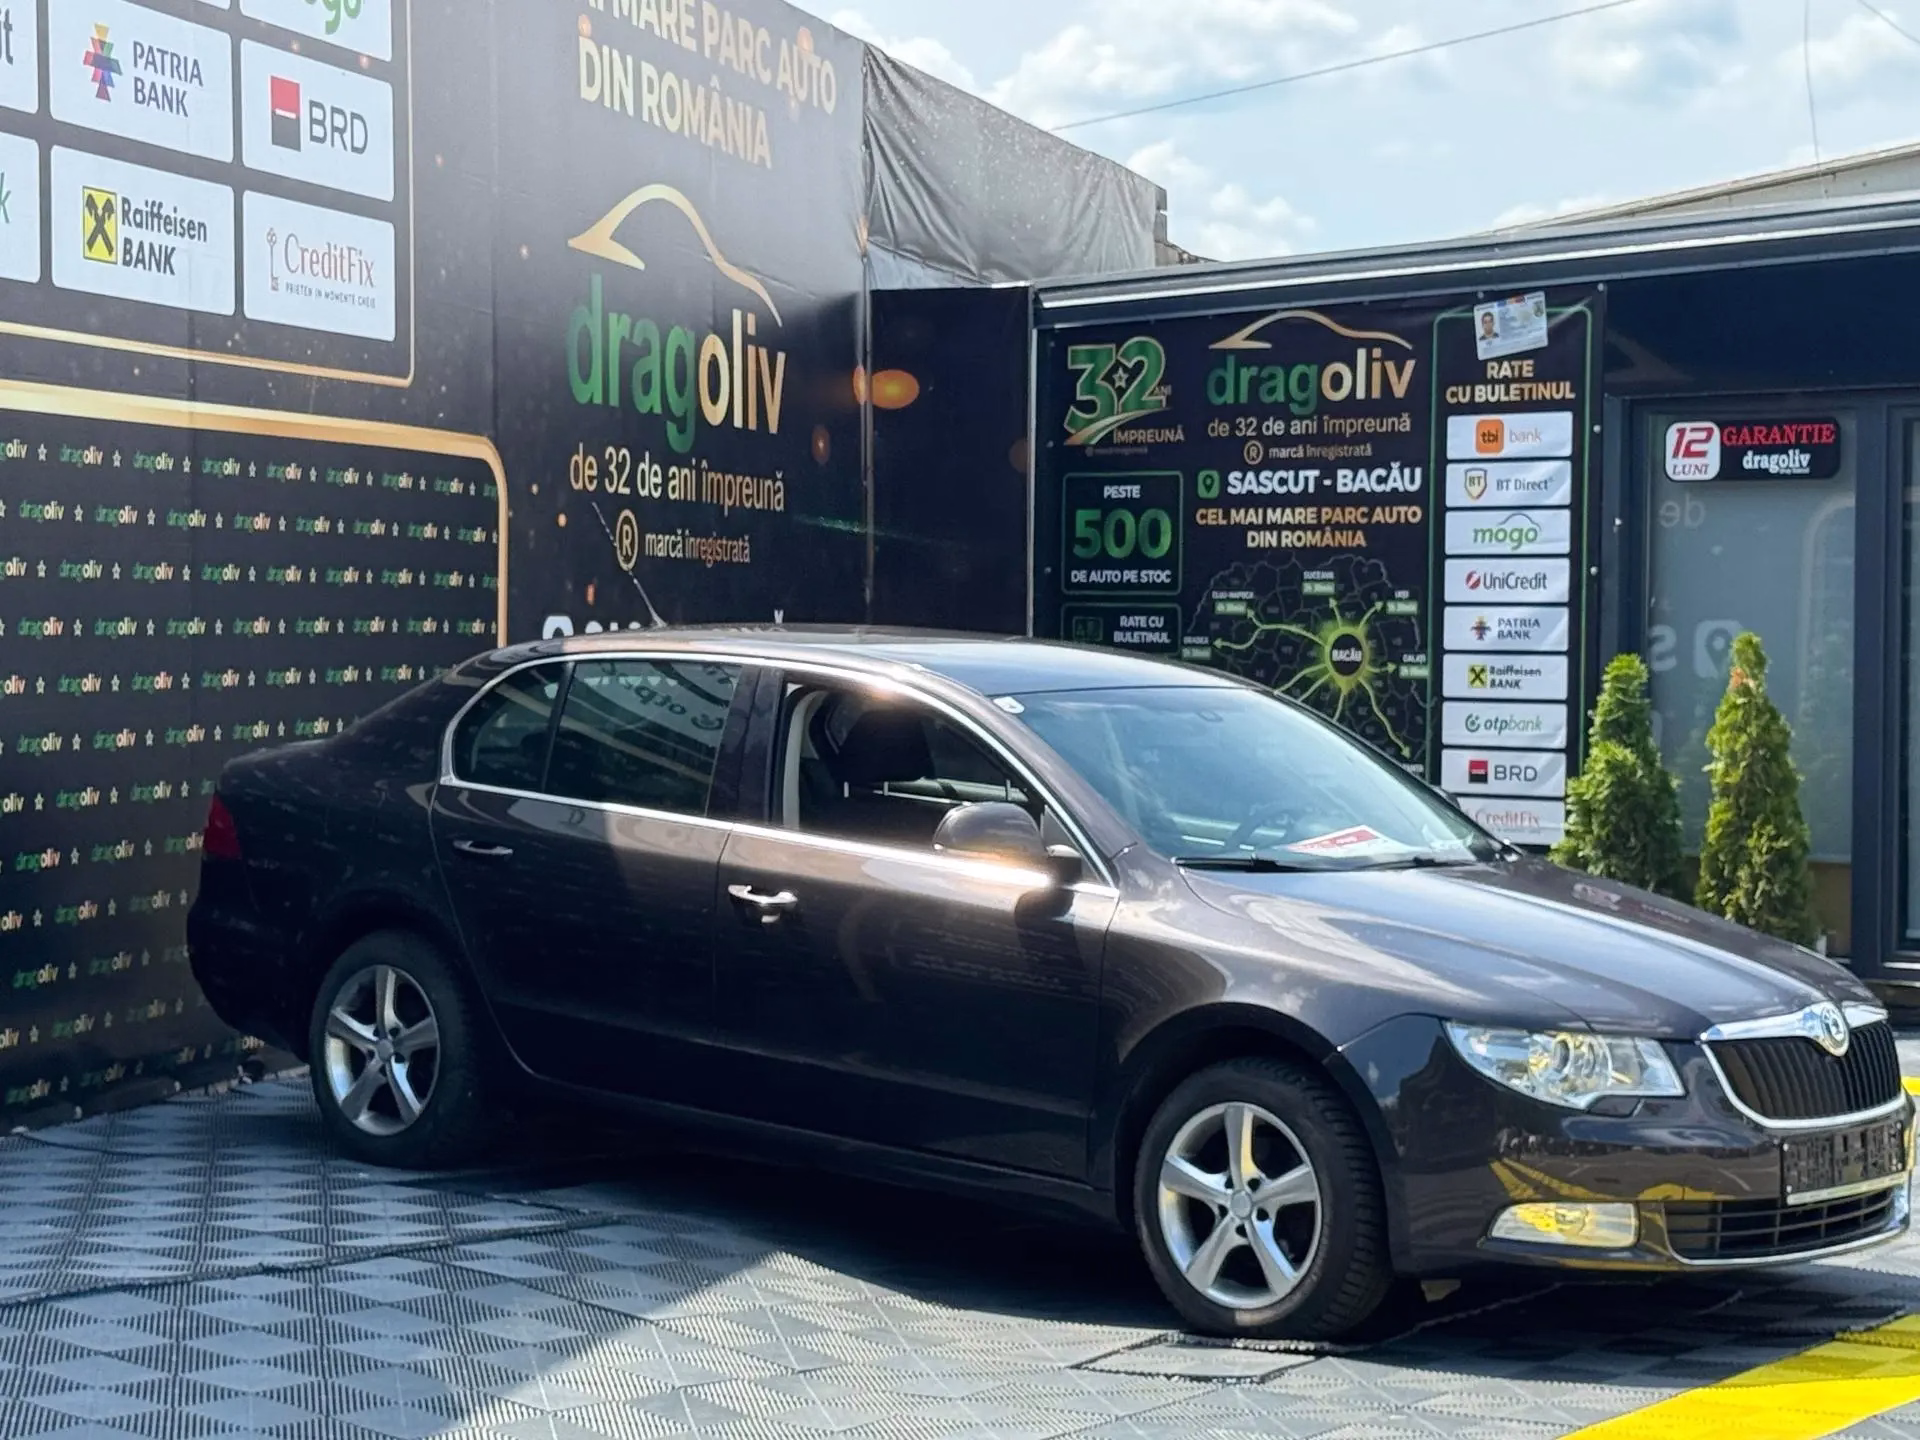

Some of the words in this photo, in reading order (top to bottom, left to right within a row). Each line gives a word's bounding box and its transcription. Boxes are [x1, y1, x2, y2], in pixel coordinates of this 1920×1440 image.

[132, 40, 204, 87] PATRIA
[702, 3, 772, 85] PARC
[776, 38, 837, 115] AUTO
[133, 76, 189, 118] BANK
[579, 35, 634, 117] DIN
[641, 60, 772, 170] ROMÂNIA
[309, 100, 368, 155] BRD
[121, 196, 208, 244] Raiffeisen
[122, 237, 176, 276] BANK
[284, 233, 375, 288] CreditFix
[566, 272, 787, 453] dragoliv
[1486, 360, 1535, 379] RATE
[1063, 336, 1166, 433] 32
[1206, 347, 1416, 416] dragoliv
[1445, 385, 1471, 404] CU
[1474, 381, 1576, 403] BULETINUL
[1208, 419, 1230, 437] de
[1235, 418, 1257, 436] 32
[1262, 416, 1285, 435] de
[1290, 416, 1317, 434] ani
[1323, 412, 1411, 438] împreună
[1481, 430, 1499, 444] tbi
[1509, 428, 1542, 444] bank
[1722, 423, 1836, 446] GARANTIE
[1269, 444, 1304, 459] marcă
[1672, 426, 1714, 459] 12
[59, 444, 103, 468] dragoliv
[132, 451, 174, 474] dragoliv
[201, 457, 241, 479] dragoliv
[1672, 463, 1710, 476] LUNI
[1742, 449, 1811, 474] dragoliv
[570, 442, 598, 492] de
[605, 446, 631, 494] 32
[637, 451, 662, 499] de
[668, 458, 696, 502] ani
[701, 462, 785, 517] împreună
[1227, 469, 1320, 495] SASCUT
[1336, 461, 1423, 493] BACĂU
[1468, 475, 1483, 488] BT
[1496, 478, 1512, 492] BT
[1514, 477, 1548, 493] Direct
[1103, 484, 1141, 499] PESTE
[19, 500, 65, 523] dragoliv
[94, 504, 138, 528] dragoliv
[166, 509, 207, 530] dragoliv
[234, 512, 271, 533] dragoliv
[1196, 508, 1229, 525] CEL
[1230, 507, 1263, 524] MAI
[1267, 507, 1317, 524] MARE
[1321, 507, 1369, 523] PARC
[1371, 506, 1422, 523] AUTO
[1072, 508, 1172, 560] 500
[1247, 532, 1279, 547] DIN
[1280, 527, 1366, 547] ROMÂNIA
[1473, 527, 1538, 551] mogo
[645, 529, 683, 558] marcă
[685, 530, 750, 568] înregistrată
[58, 559, 103, 582] dragoliv
[131, 561, 174, 584] dragoliv
[201, 563, 241, 585] dragoliv
[1071, 570, 1088, 584] DE
[1089, 570, 1120, 584] AUTO
[1121, 570, 1138, 583] PE
[1139, 569, 1171, 583] STOC
[1483, 571, 1548, 591] UniCredit
[17, 616, 64, 640] dragoliv
[94, 616, 138, 640] dragoliv
[165, 616, 207, 639] dragoliv
[232, 616, 271, 638] dragoliv
[1120, 615, 1146, 628] RATE
[1148, 615, 1164, 628] CU
[1497, 617, 1541, 630] PATRIA
[1112, 629, 1171, 644] BULETINUL
[1497, 629, 1531, 642] BANK
[57, 673, 102, 697] dragoliv
[131, 671, 173, 694] dragoliv
[201, 668, 240, 691] dragoliv
[1489, 664, 1542, 677] Raiffeisen
[1489, 677, 1521, 690] BANK
[1483, 712, 1543, 736] otpbank
[17, 732, 62, 756] dragoliv
[93, 728, 137, 752] dragoliv
[164, 724, 206, 747] dragoliv
[232, 720, 270, 742] dragoliv
[1493, 764, 1538, 783] BRD
[56, 786, 100, 810] dragoliv
[131, 780, 172, 804] dragoliv
